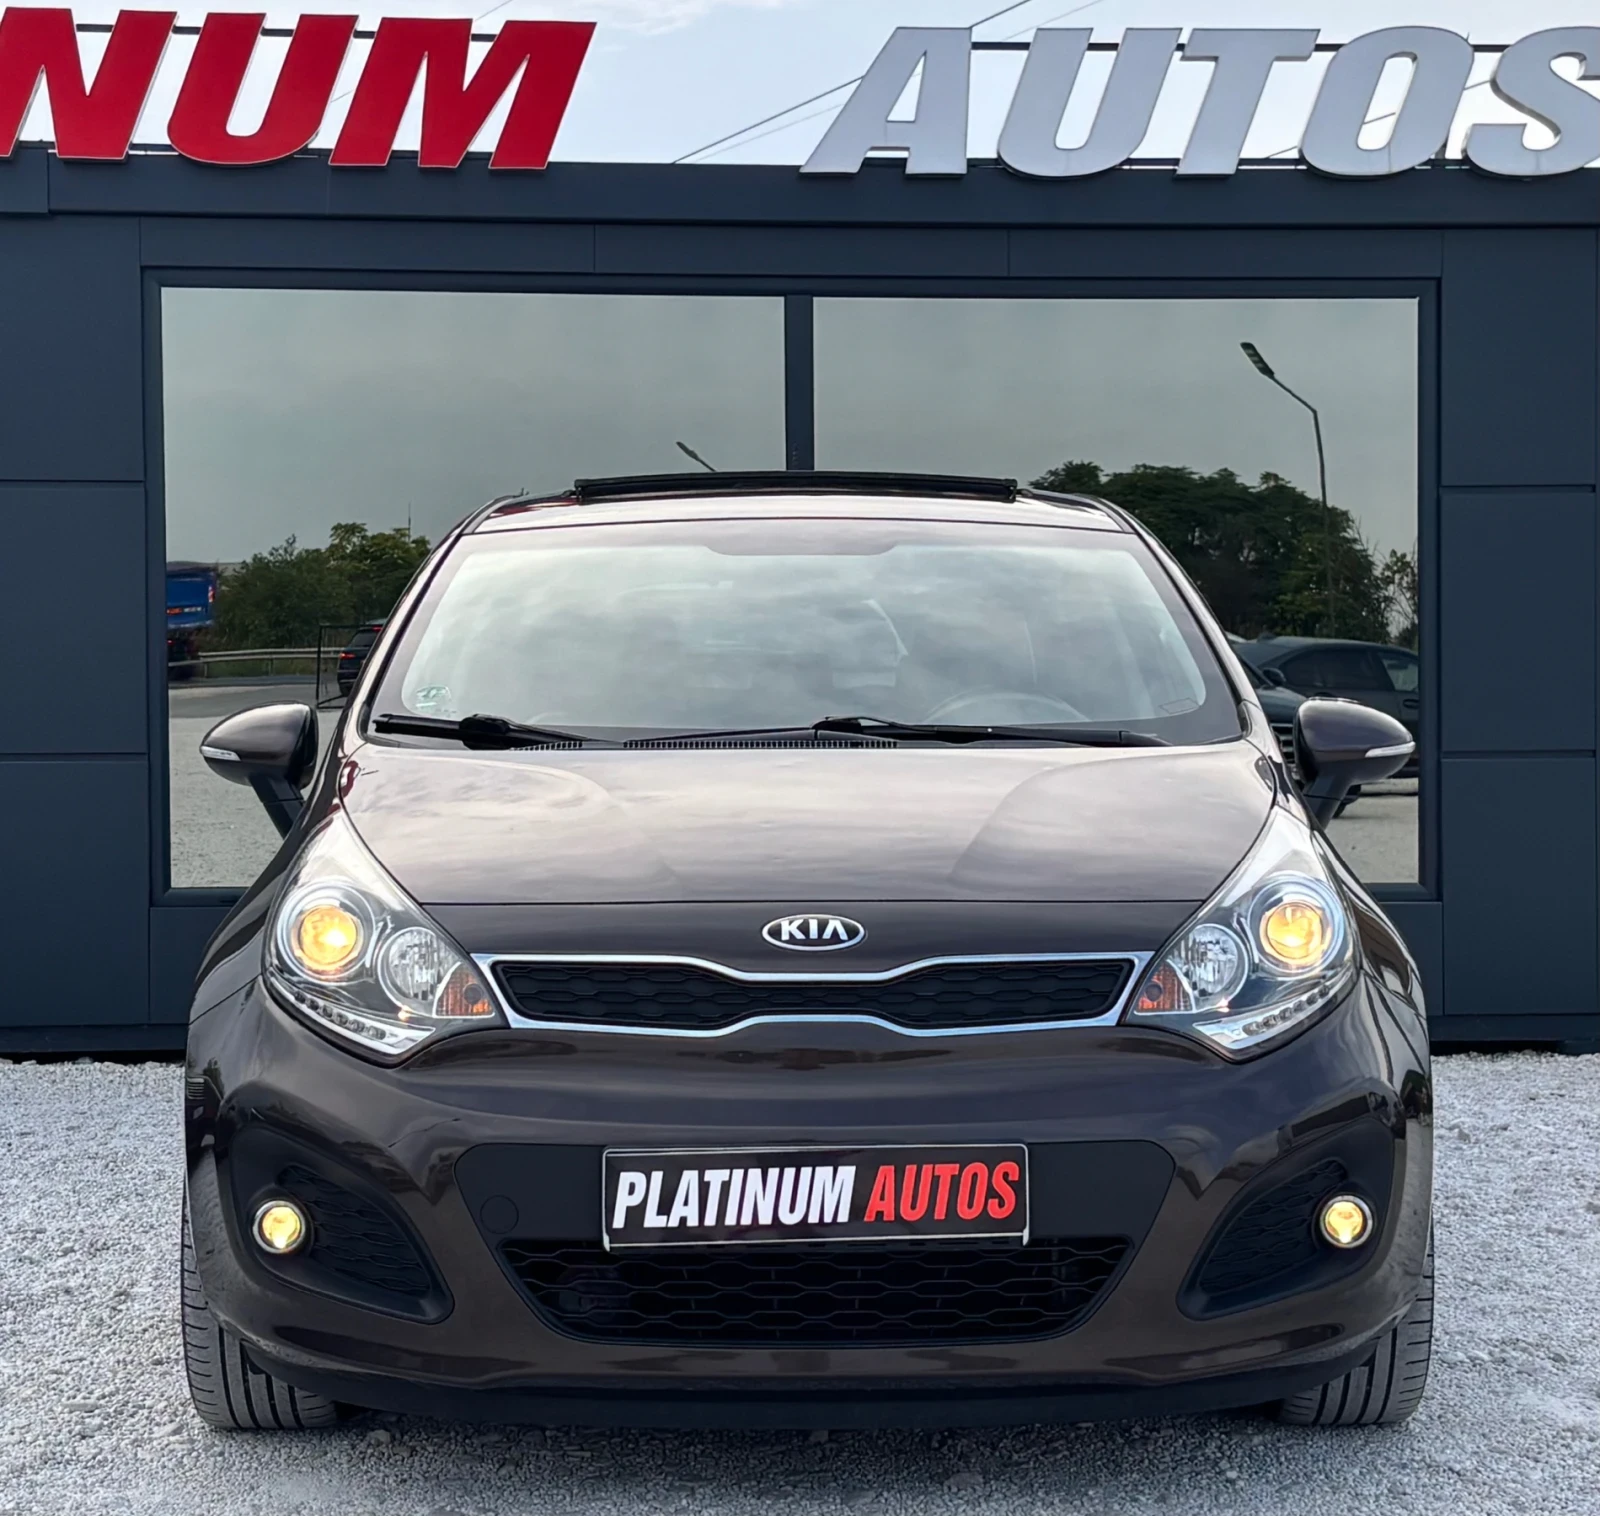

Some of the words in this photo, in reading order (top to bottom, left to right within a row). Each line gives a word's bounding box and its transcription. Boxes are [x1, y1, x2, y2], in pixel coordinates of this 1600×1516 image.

[0, 7, 596, 170] NUM
[800, 25, 1600, 179] AUTOS
[780, 918, 849, 941] KIA
[612, 1165, 857, 1229] PLATINUM
[863, 1161, 1020, 1222] AUTOS
